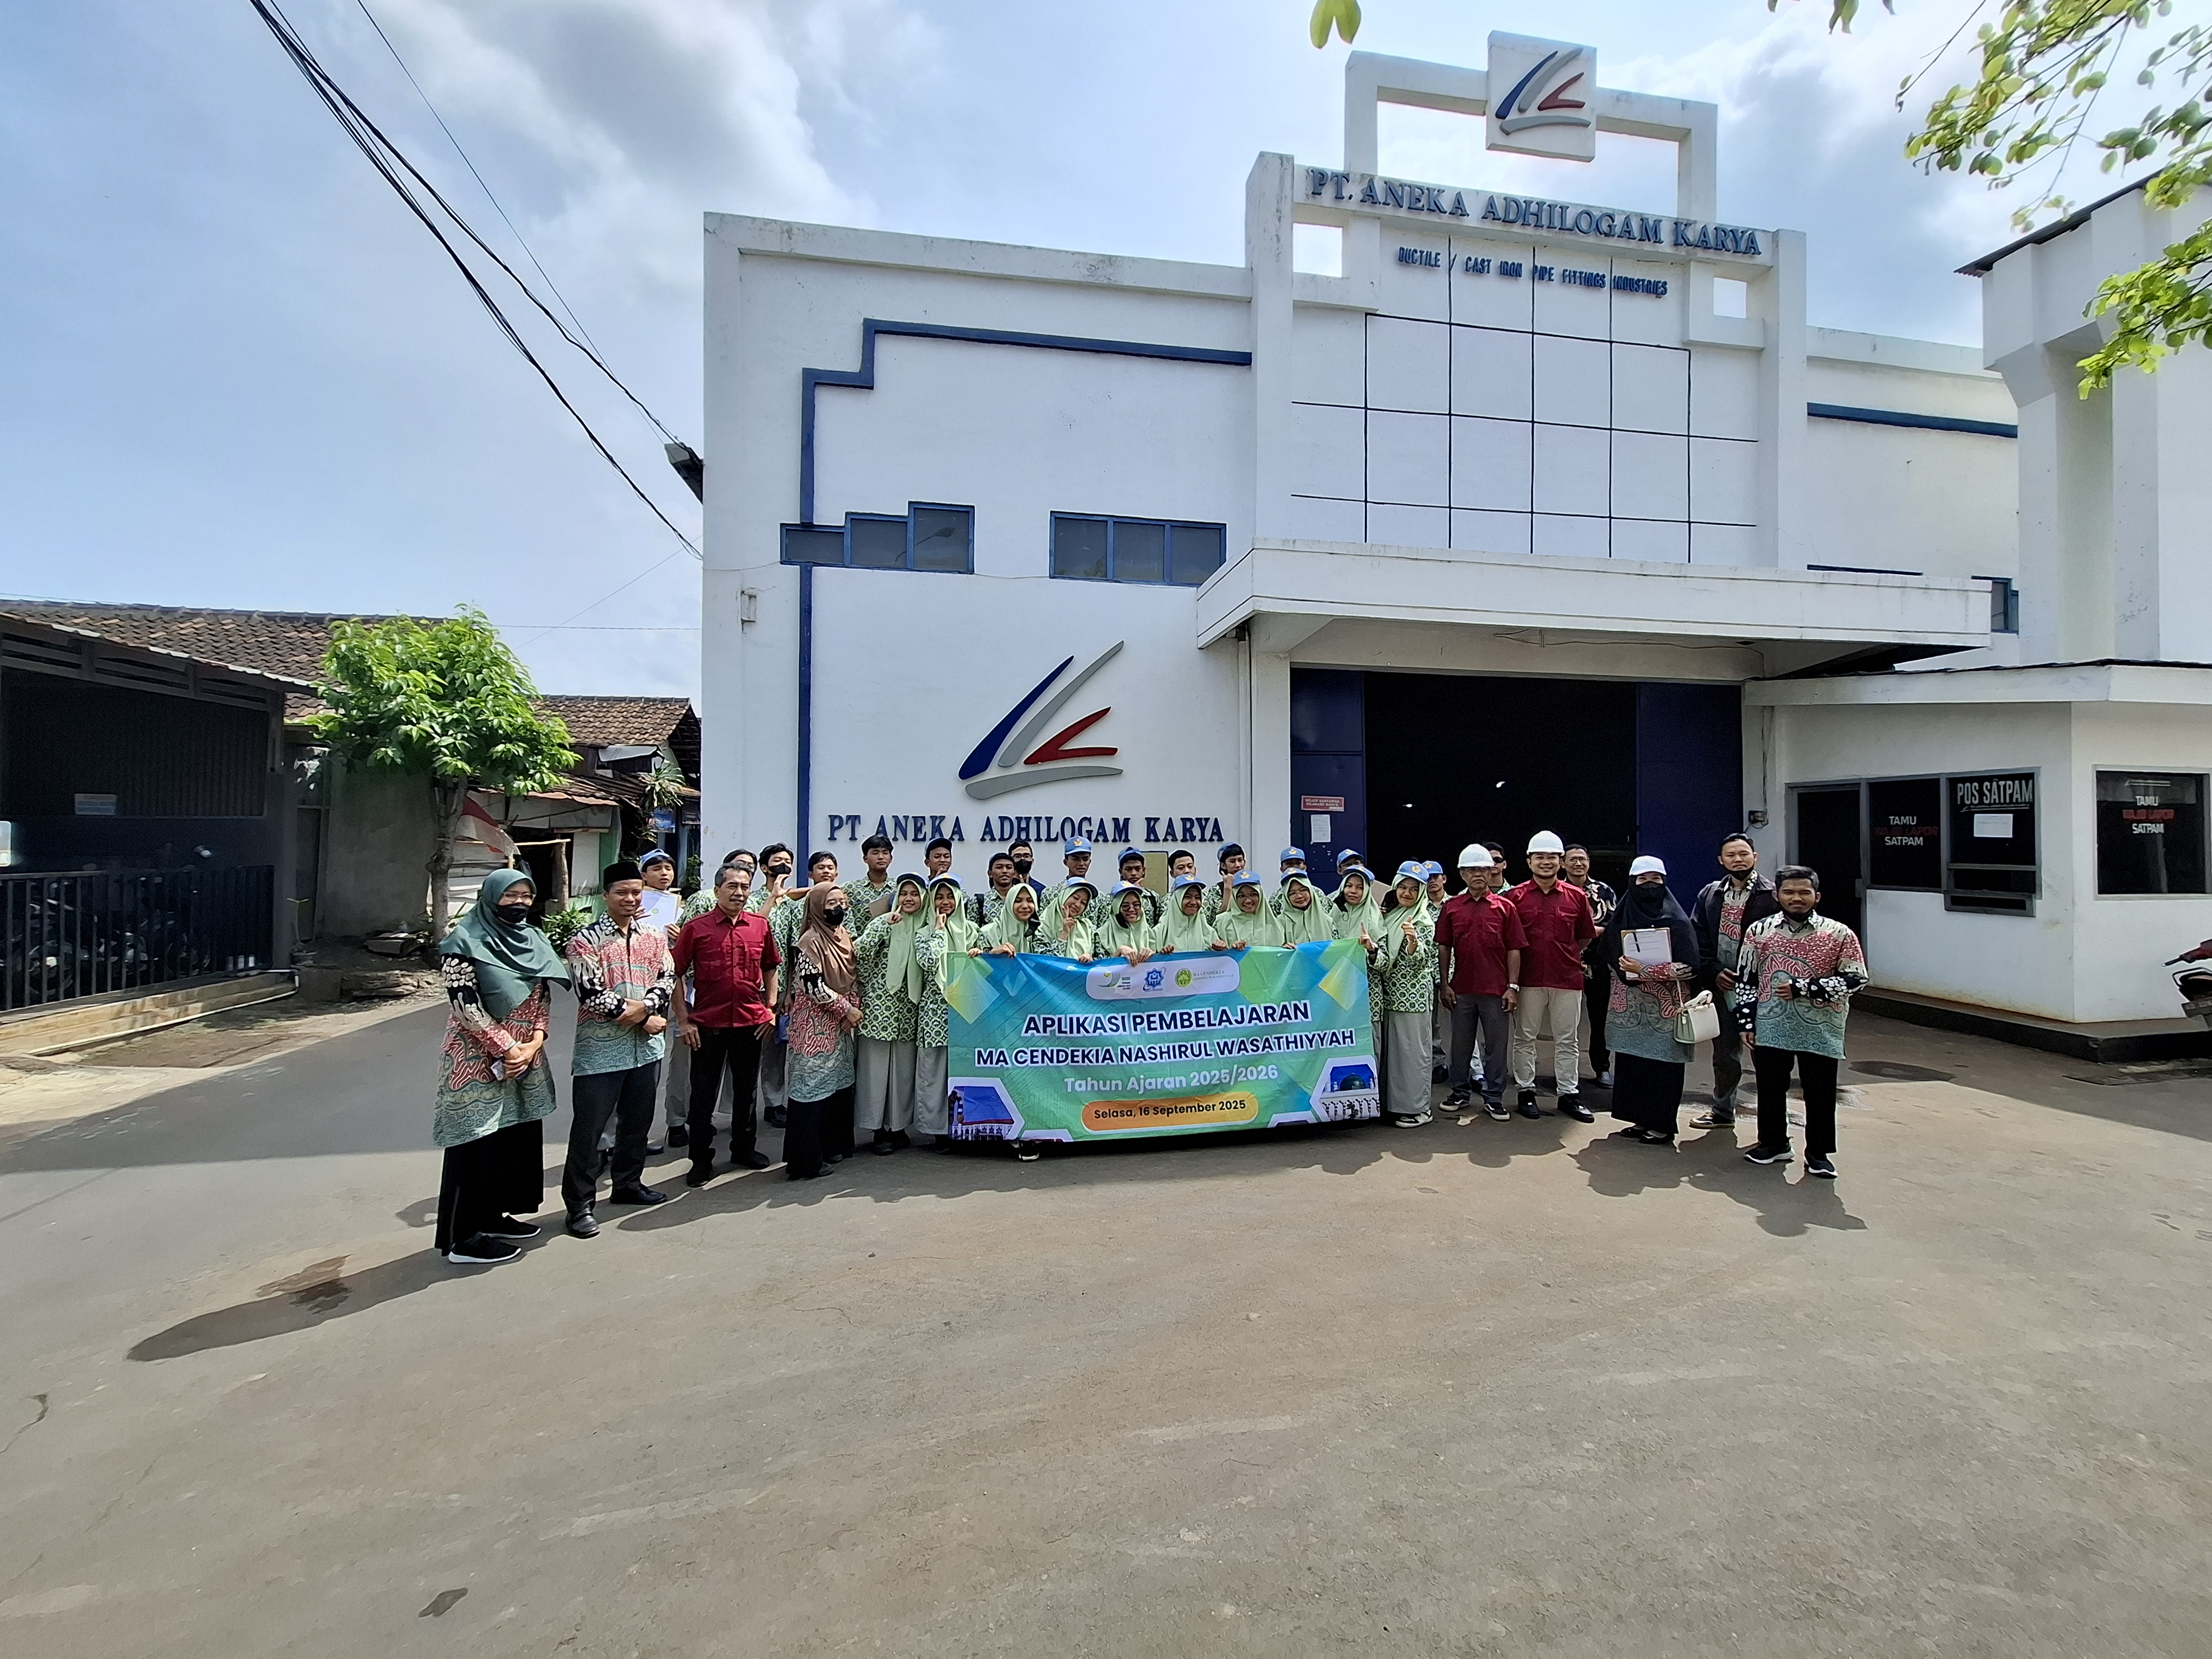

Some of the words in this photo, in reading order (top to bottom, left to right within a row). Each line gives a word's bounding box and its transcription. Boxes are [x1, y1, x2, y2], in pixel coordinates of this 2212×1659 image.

[1310, 168, 1353, 201] PT.
[1360, 178, 1470, 217] ANEKA
[1481, 195, 1664, 243] ADHILOGAM
[1673, 221, 1761, 255] KARYA
[1398, 247, 1441, 267] DUCTILE
[1465, 256, 1492, 274] CAST
[1499, 260, 1522, 278] IRON
[1533, 264, 1555, 281] PIPE
[1562, 268, 1606, 288] FITTINGS
[1612, 275, 1668, 295] INDUSTRIES
[1957, 782, 1979, 805] POS
[2134, 796, 2158, 806] TAMU
[827, 814, 861, 841] PT
[875, 814, 965, 841] ANEKA
[980, 815, 1131, 843] ADHILOGAM
[1144, 816, 1224, 843] KARYA
[1888, 816, 1917, 825] TAMU
[1885, 837, 1924, 846] SATPAM
[1023, 1014, 1127, 1035] APLIKASI
[1132, 1001, 1310, 1033] PEMBELAJARAN
[976, 1049, 1009, 1066] MA
[1013, 1047, 1115, 1065] CENDEKIA
[1120, 1043, 1212, 1063] NASHIRUL
[1217, 1030, 1354, 1056] WASATHIYYAH
[1064, 1077, 1122, 1092] Tahun
[1127, 1074, 1186, 1095] Ajaran
[1191, 1065, 1278, 1086] 2025/2026
[1094, 1108, 1136, 1119] Selasa,
[1138, 1107, 1150, 1117] 16
[1153, 1102, 1217, 1118] September
[1219, 1099, 1246, 1110] 2025
